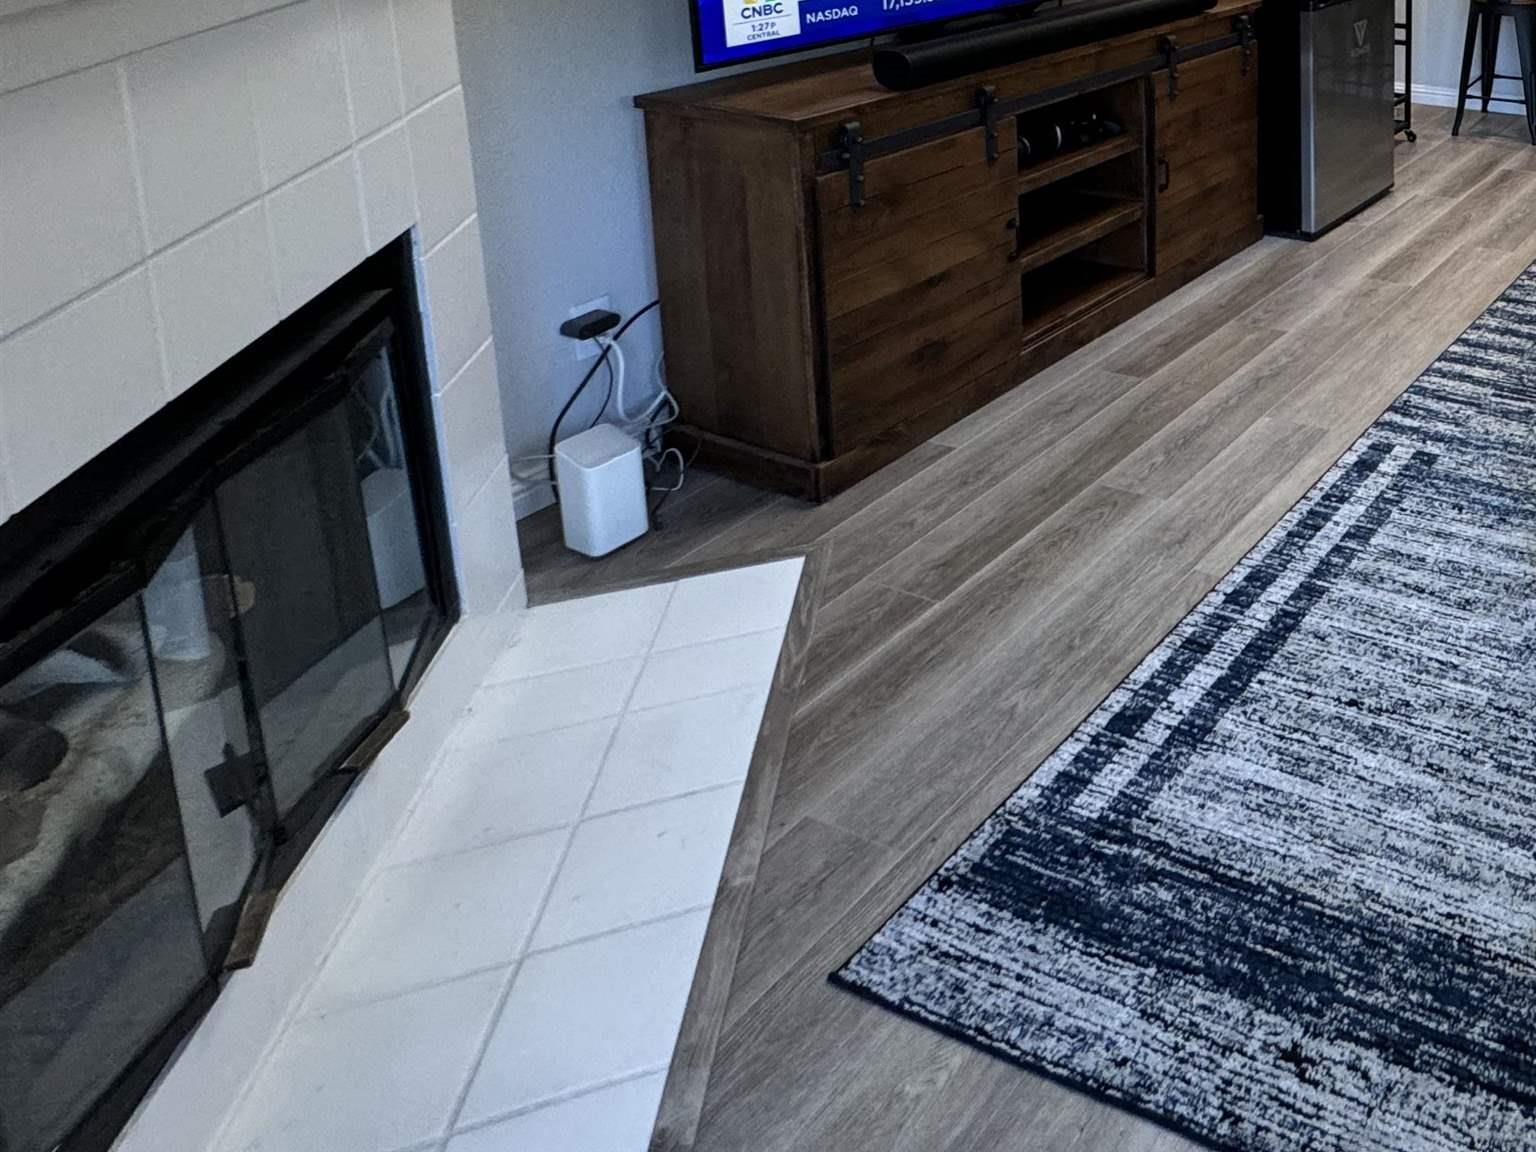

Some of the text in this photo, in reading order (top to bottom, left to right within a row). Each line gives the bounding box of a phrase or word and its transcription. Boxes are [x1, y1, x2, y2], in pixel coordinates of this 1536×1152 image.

[741, 2, 784, 20] CNBC
[806, 5, 859, 24] NASDAQ
[747, 30, 780, 41] CENTRAL
